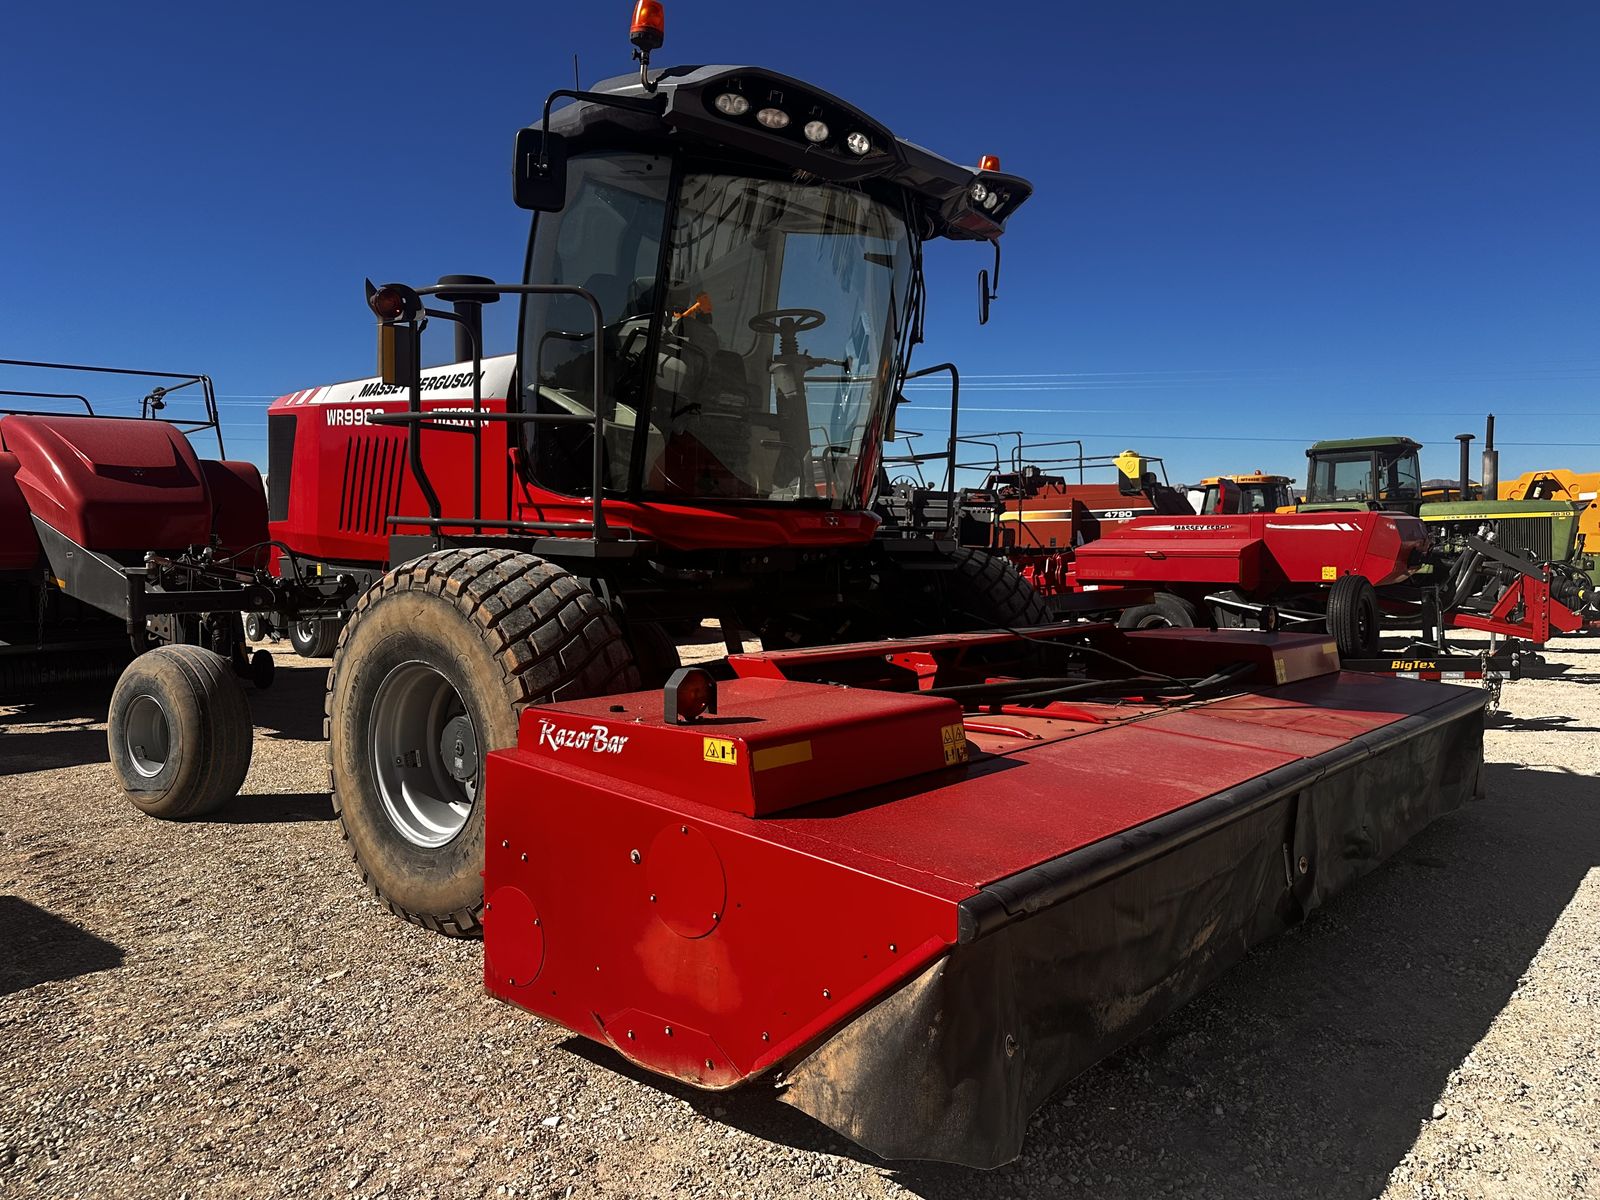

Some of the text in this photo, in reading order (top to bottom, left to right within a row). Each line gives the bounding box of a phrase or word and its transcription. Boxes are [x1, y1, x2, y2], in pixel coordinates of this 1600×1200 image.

[417, 370, 486, 392] ERGUSO
[1391, 660, 1436, 671] BigTex
[537, 717, 629, 754] RazorBar
